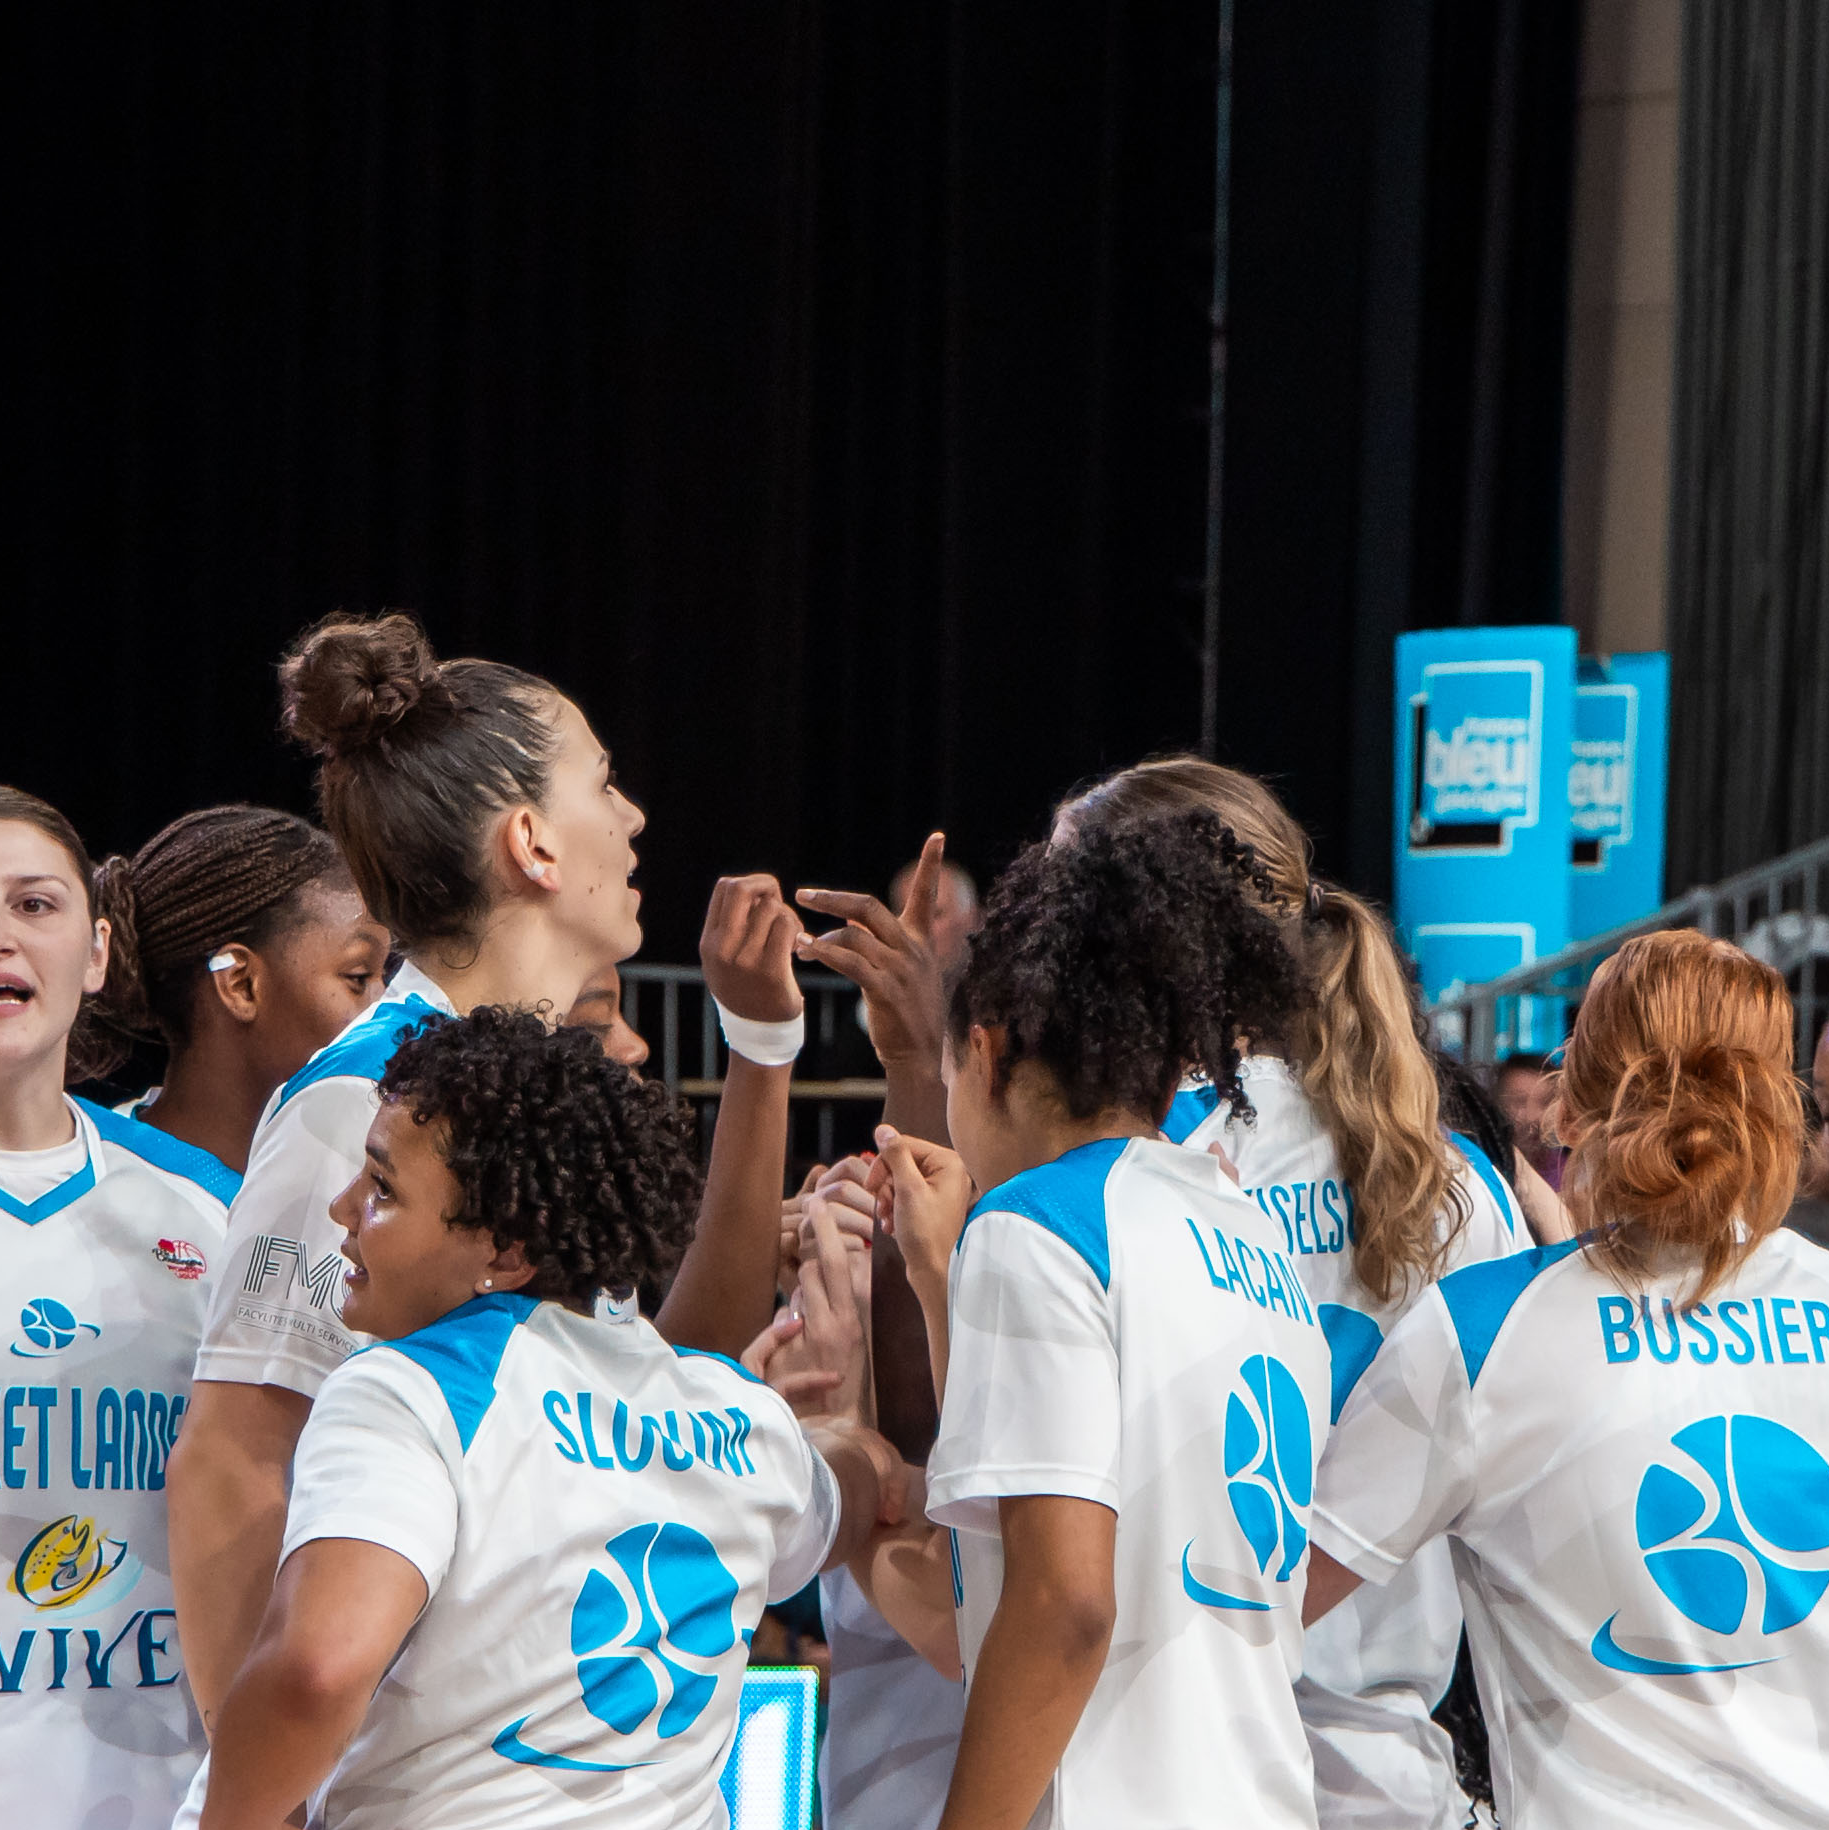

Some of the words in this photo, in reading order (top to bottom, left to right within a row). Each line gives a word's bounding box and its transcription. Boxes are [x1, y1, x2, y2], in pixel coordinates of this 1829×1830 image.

[1425, 728, 1528, 787] bleu
[1185, 1216, 1315, 1327] LACAN
[318, 1327, 360, 1354] SERVICE
[71, 1383, 189, 1492] LANDE
